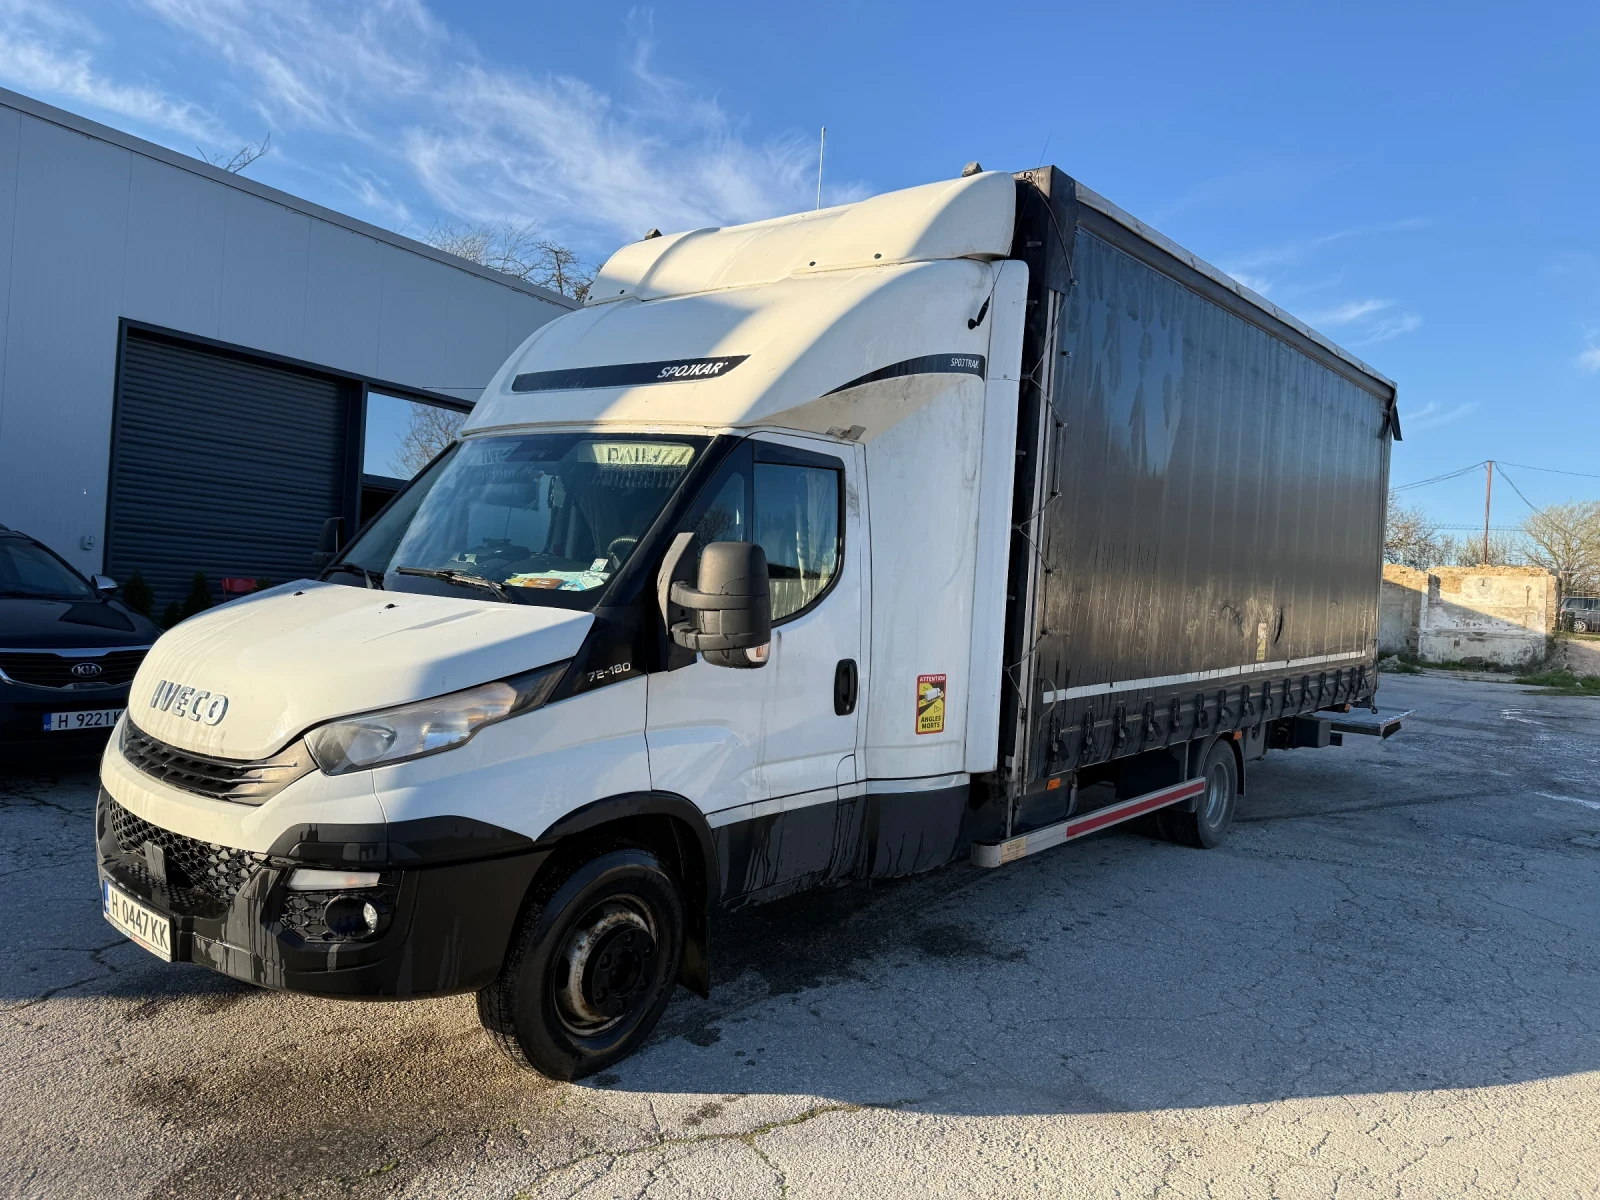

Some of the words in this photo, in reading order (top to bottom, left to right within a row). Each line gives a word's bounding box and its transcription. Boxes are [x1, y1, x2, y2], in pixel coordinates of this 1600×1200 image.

[657, 362, 724, 378] SPOJKAR
[76, 666, 99, 676] KIA
[587, 662, 631, 681] 72-180
[149, 680, 229, 727] IVECO
[58, 714, 69, 729] H
[111, 890, 119, 918] H
